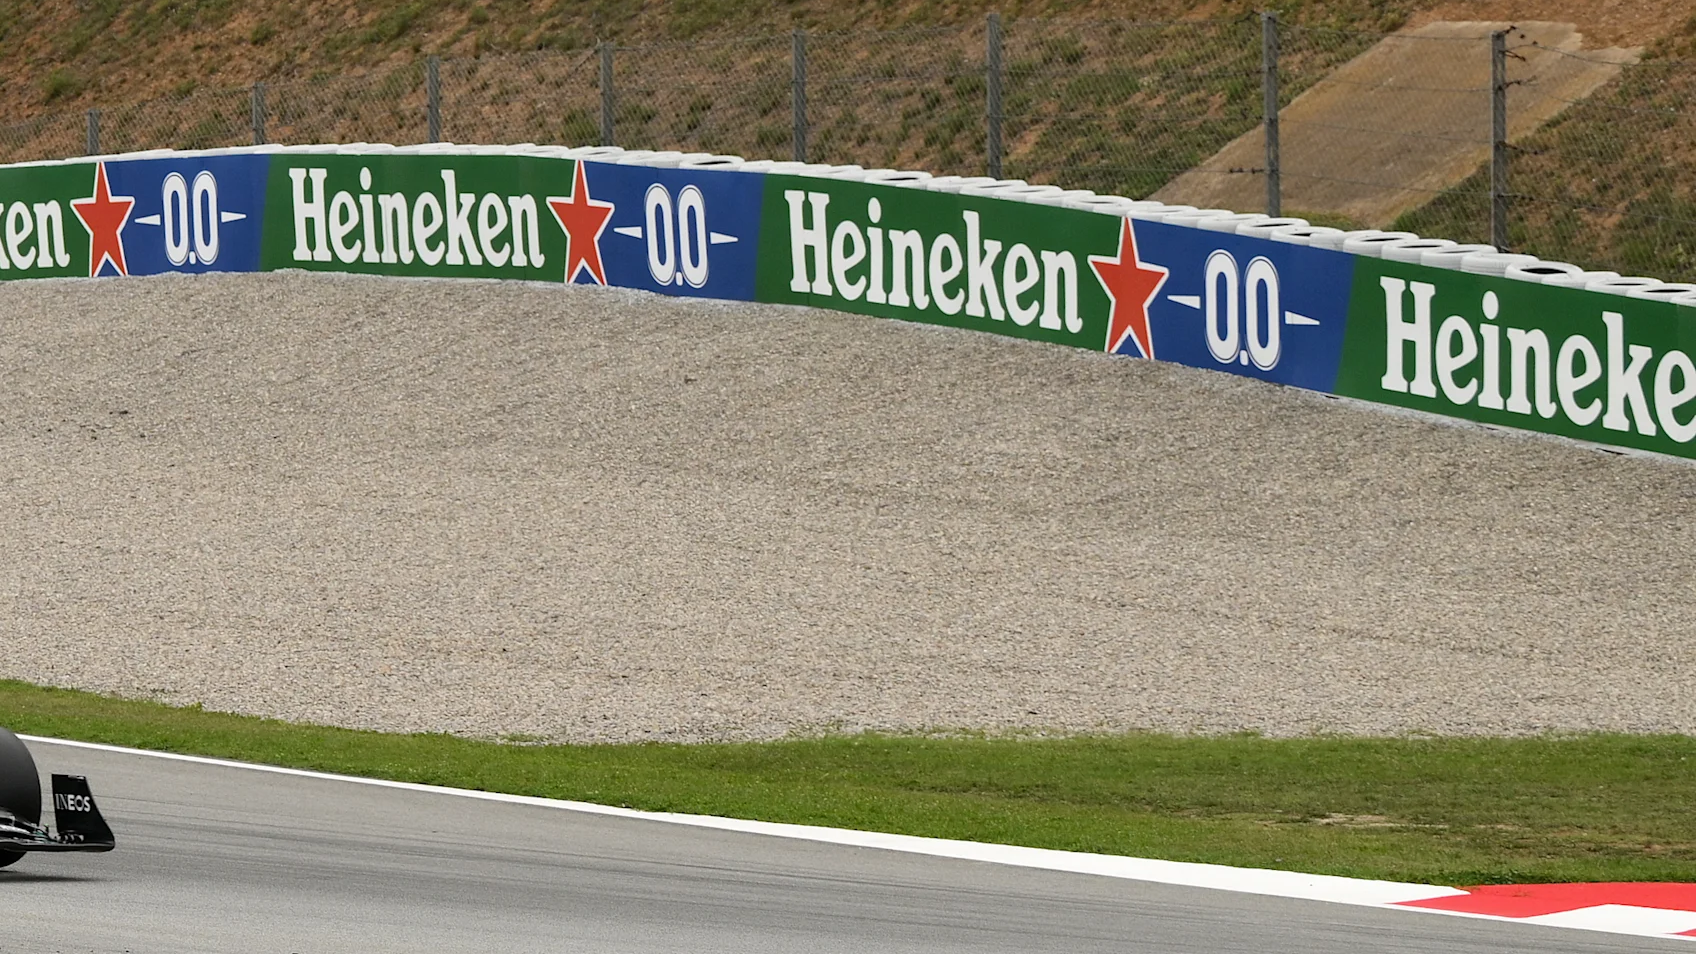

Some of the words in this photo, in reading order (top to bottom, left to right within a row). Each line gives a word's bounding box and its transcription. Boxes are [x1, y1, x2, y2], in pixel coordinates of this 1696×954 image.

[289, 166, 546, 269] Heineken
[783, 189, 1083, 334] Heineken
[55, 793, 91, 812] INEOS
